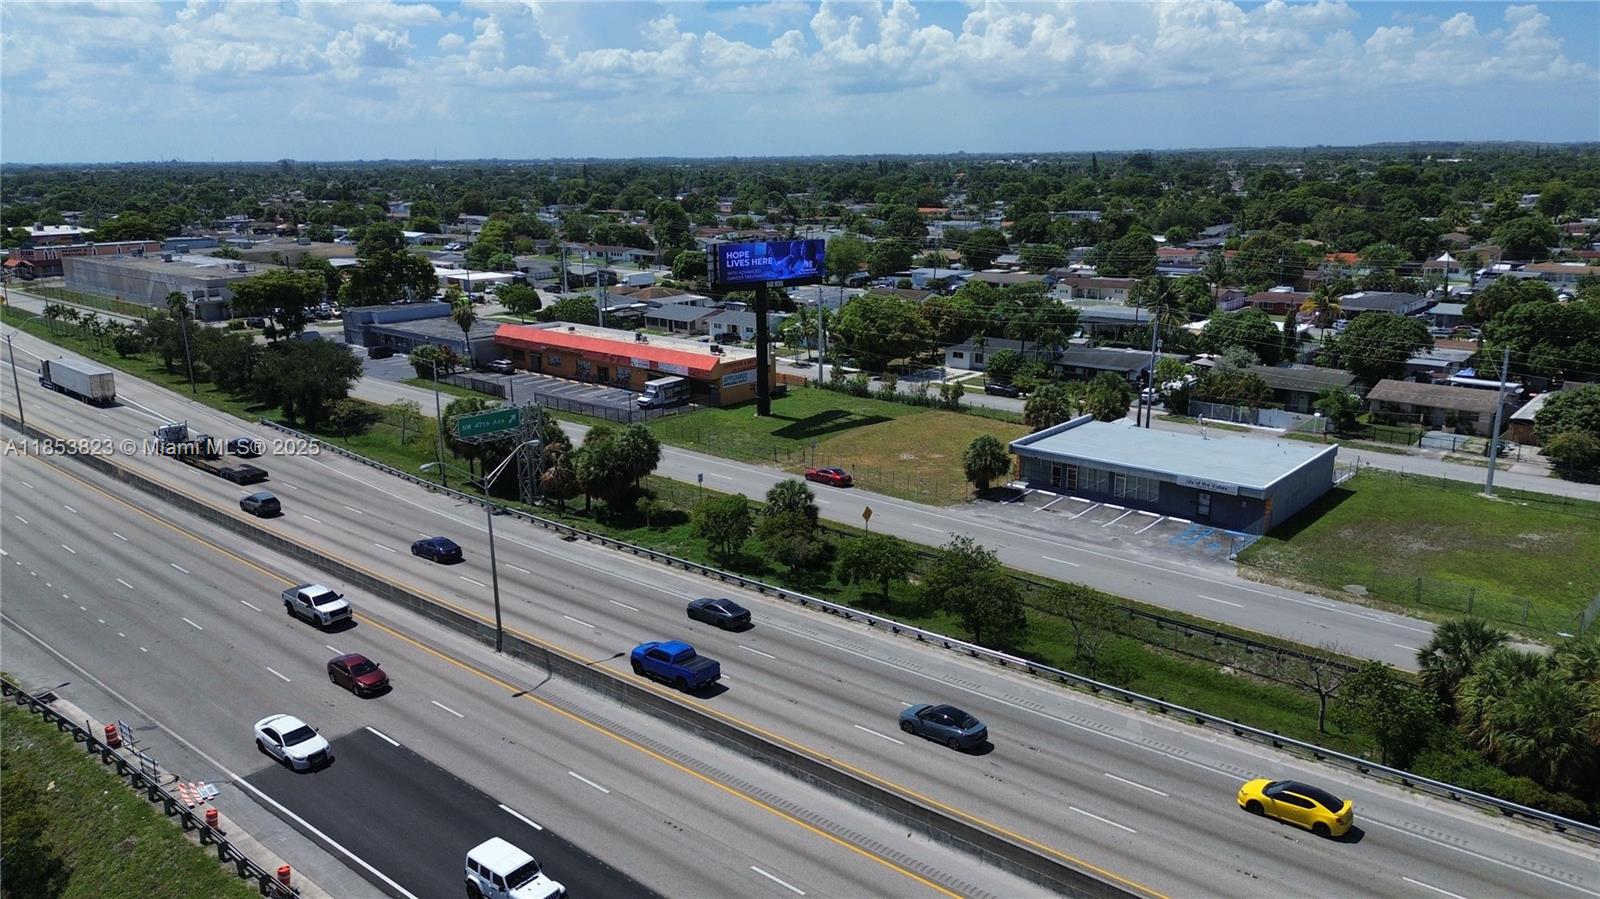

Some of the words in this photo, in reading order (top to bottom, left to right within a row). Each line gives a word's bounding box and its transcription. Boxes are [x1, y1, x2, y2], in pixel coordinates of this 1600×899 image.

[726, 251, 750, 259] HOPE
[726, 259, 750, 268] LIVES
[751, 257, 773, 266] HERE
